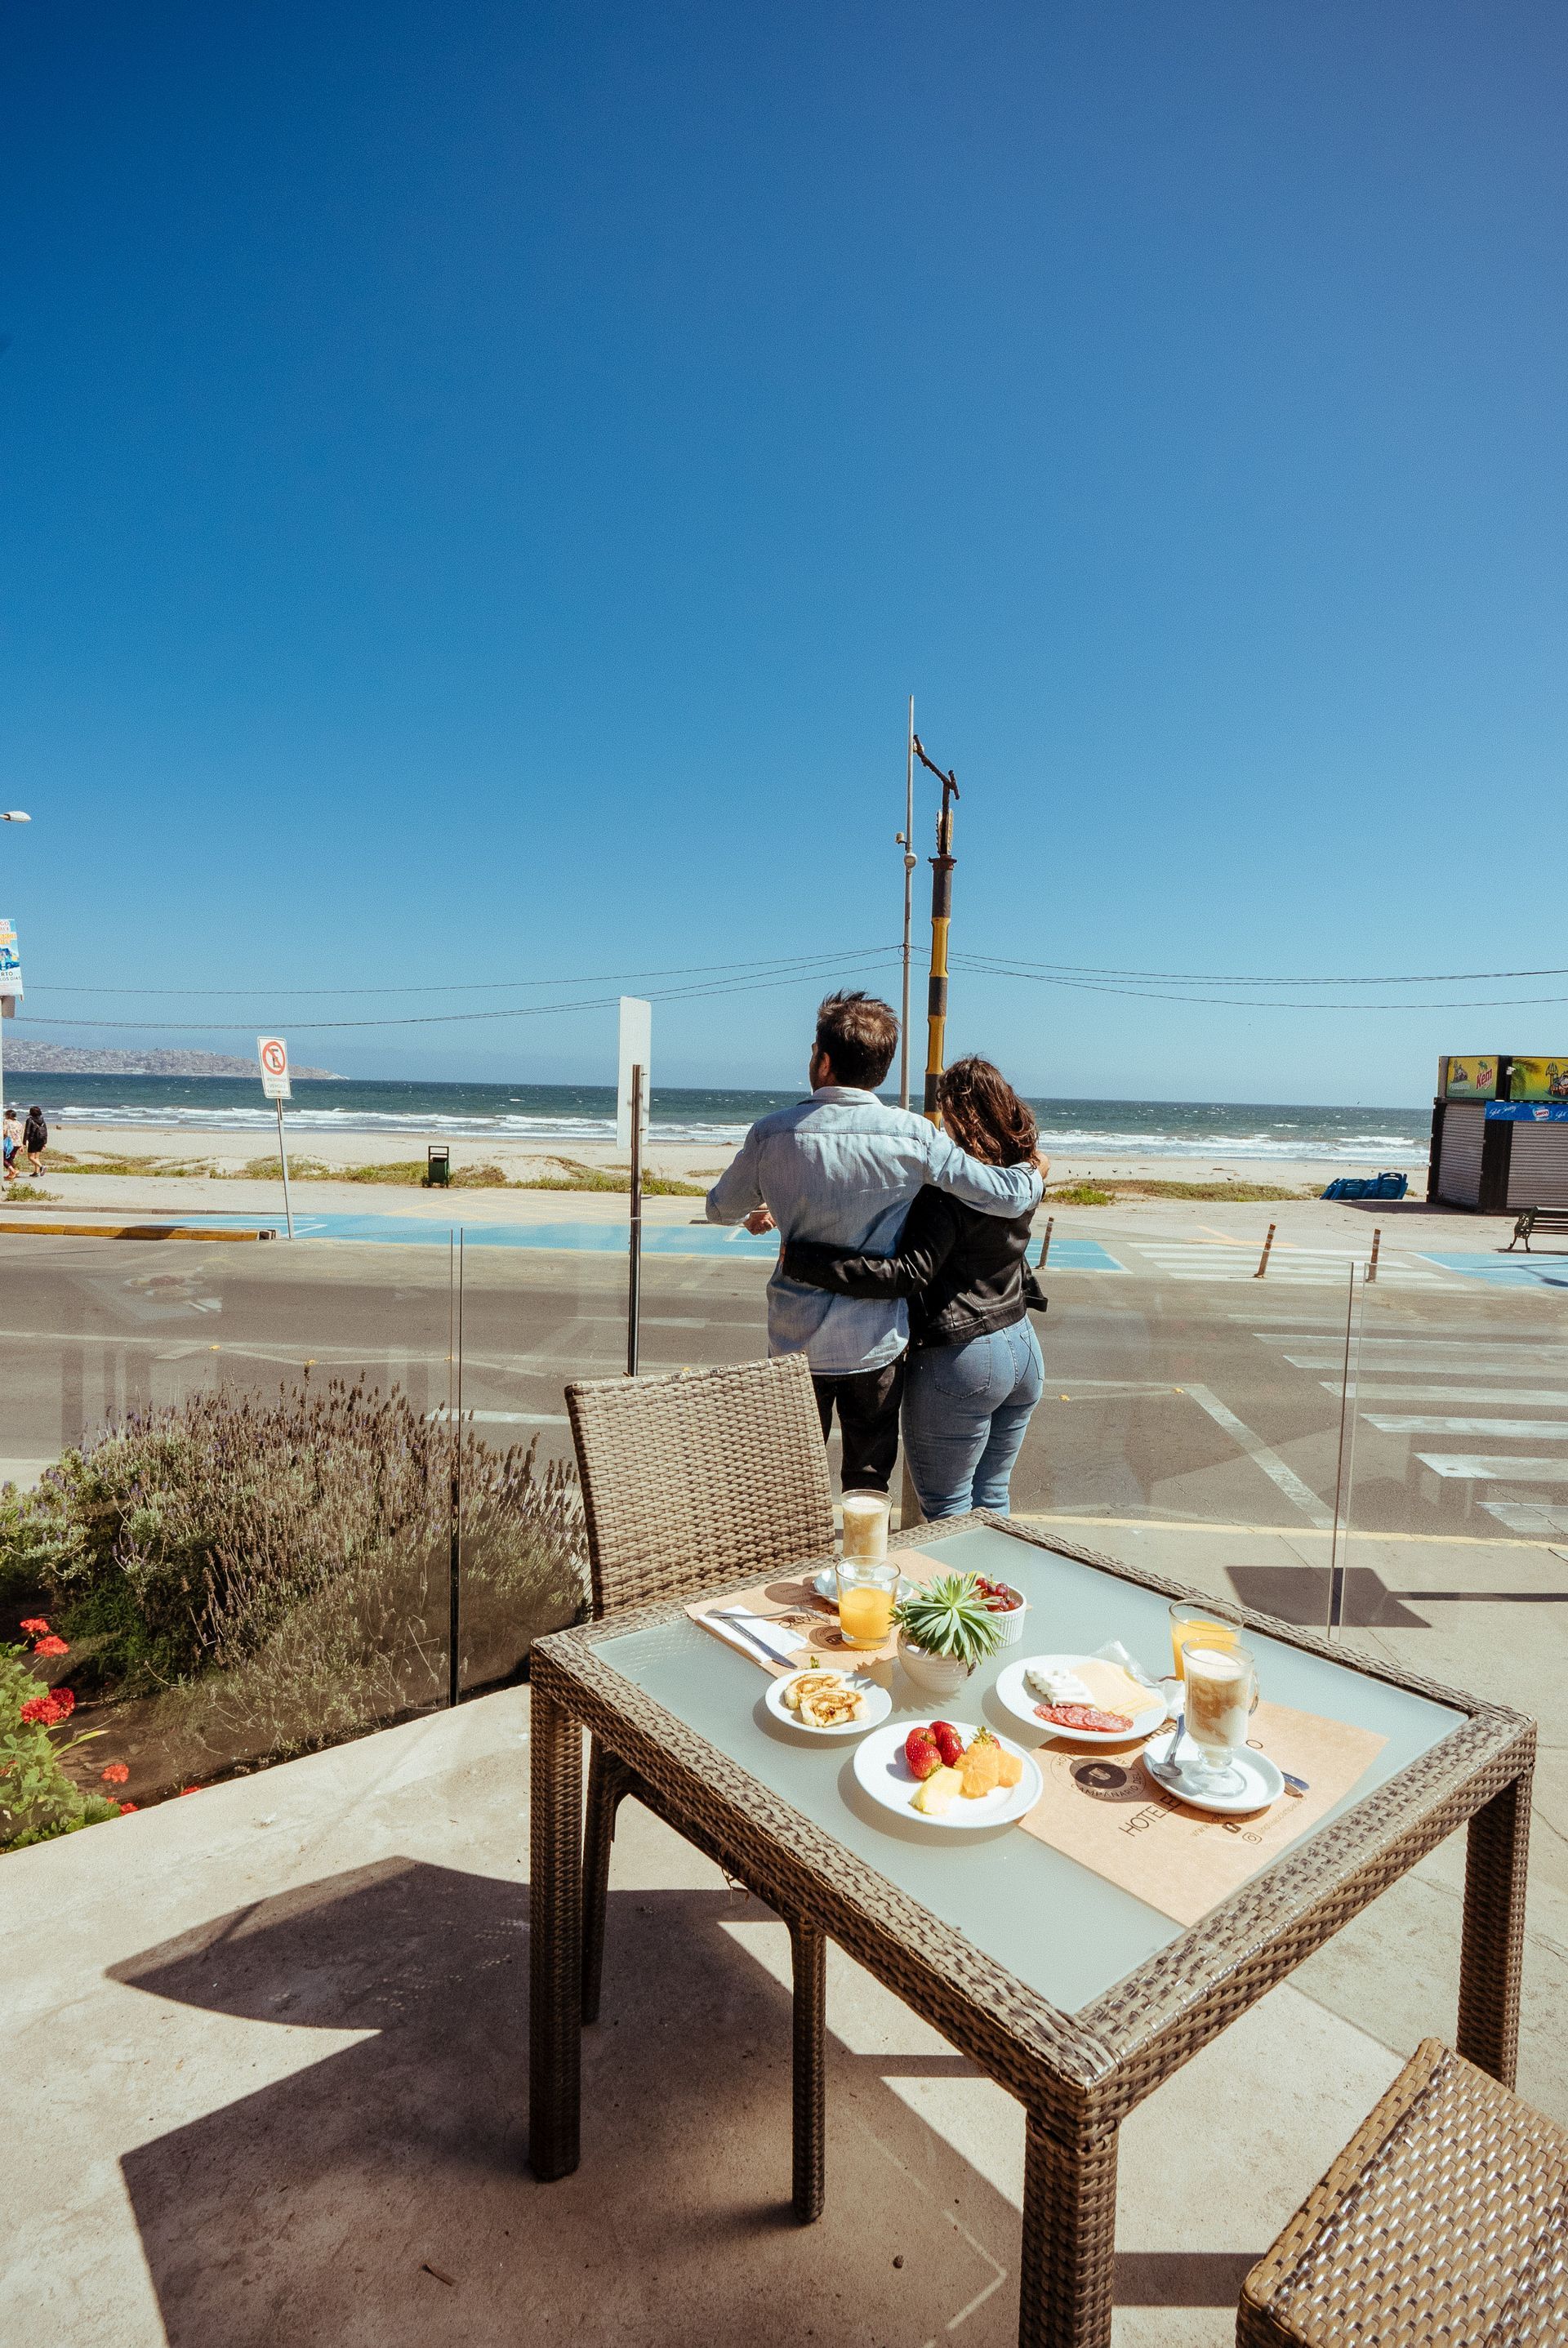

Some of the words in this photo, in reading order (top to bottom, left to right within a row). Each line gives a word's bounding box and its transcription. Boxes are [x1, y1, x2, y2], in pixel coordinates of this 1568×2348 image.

[1476, 1068, 1493, 1089] Kem
[1071, 1784, 1139, 1798] CAMPANARIO
[1118, 1804, 1175, 1838] HOTEL
